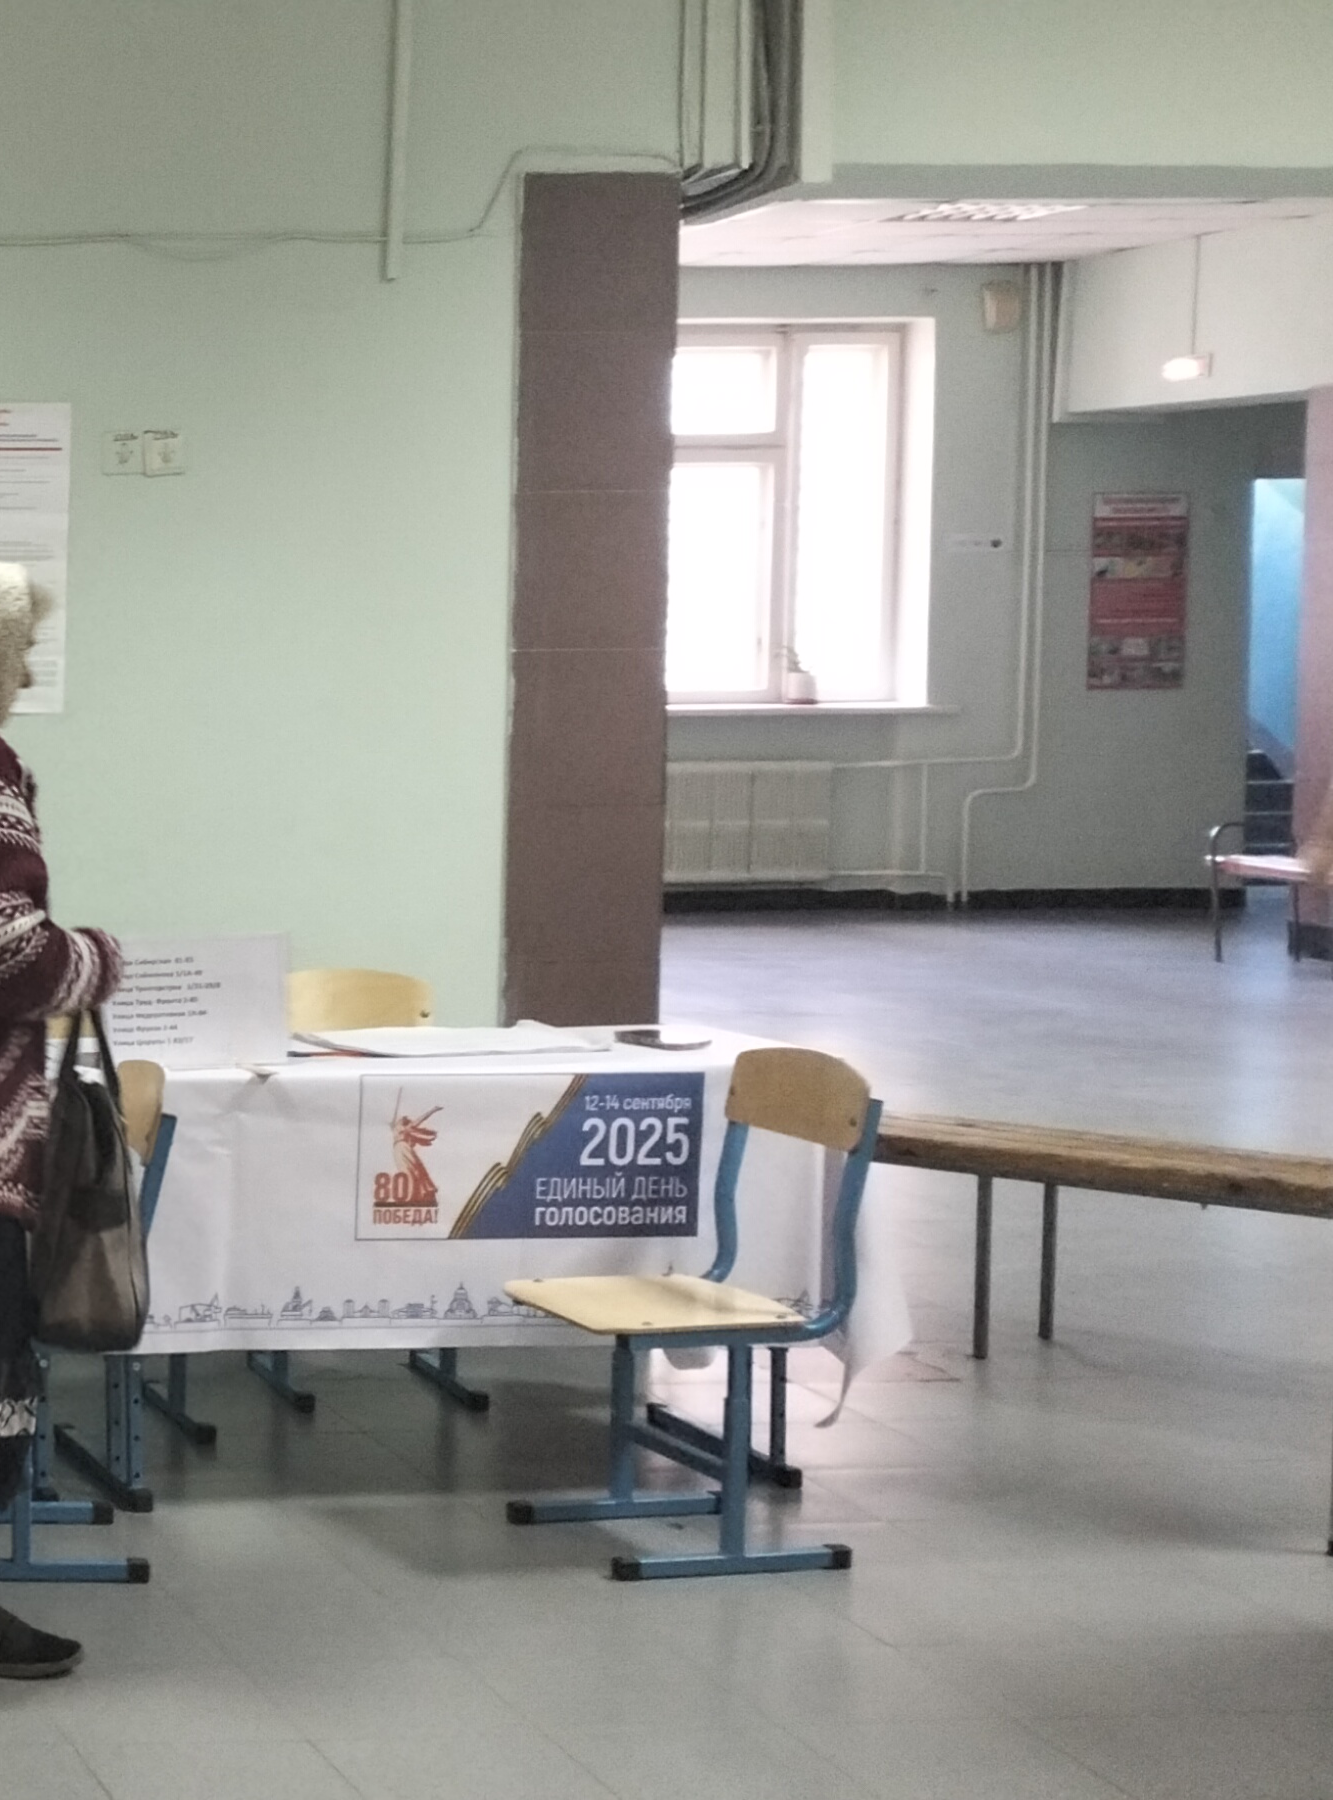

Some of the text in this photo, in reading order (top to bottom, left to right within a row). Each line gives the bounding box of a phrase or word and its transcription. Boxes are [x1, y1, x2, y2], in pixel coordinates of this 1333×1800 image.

[584, 1094, 692, 1113] 12-14 сентября
[580, 1117, 690, 1166] 2025
[374, 1172, 409, 1203] 80
[536, 1172, 688, 1202] ЕДИНЫЙ ДЕНЬ
[373, 1208, 438, 1226] ПОБЕДА!
[535, 1206, 688, 1226] голосования
